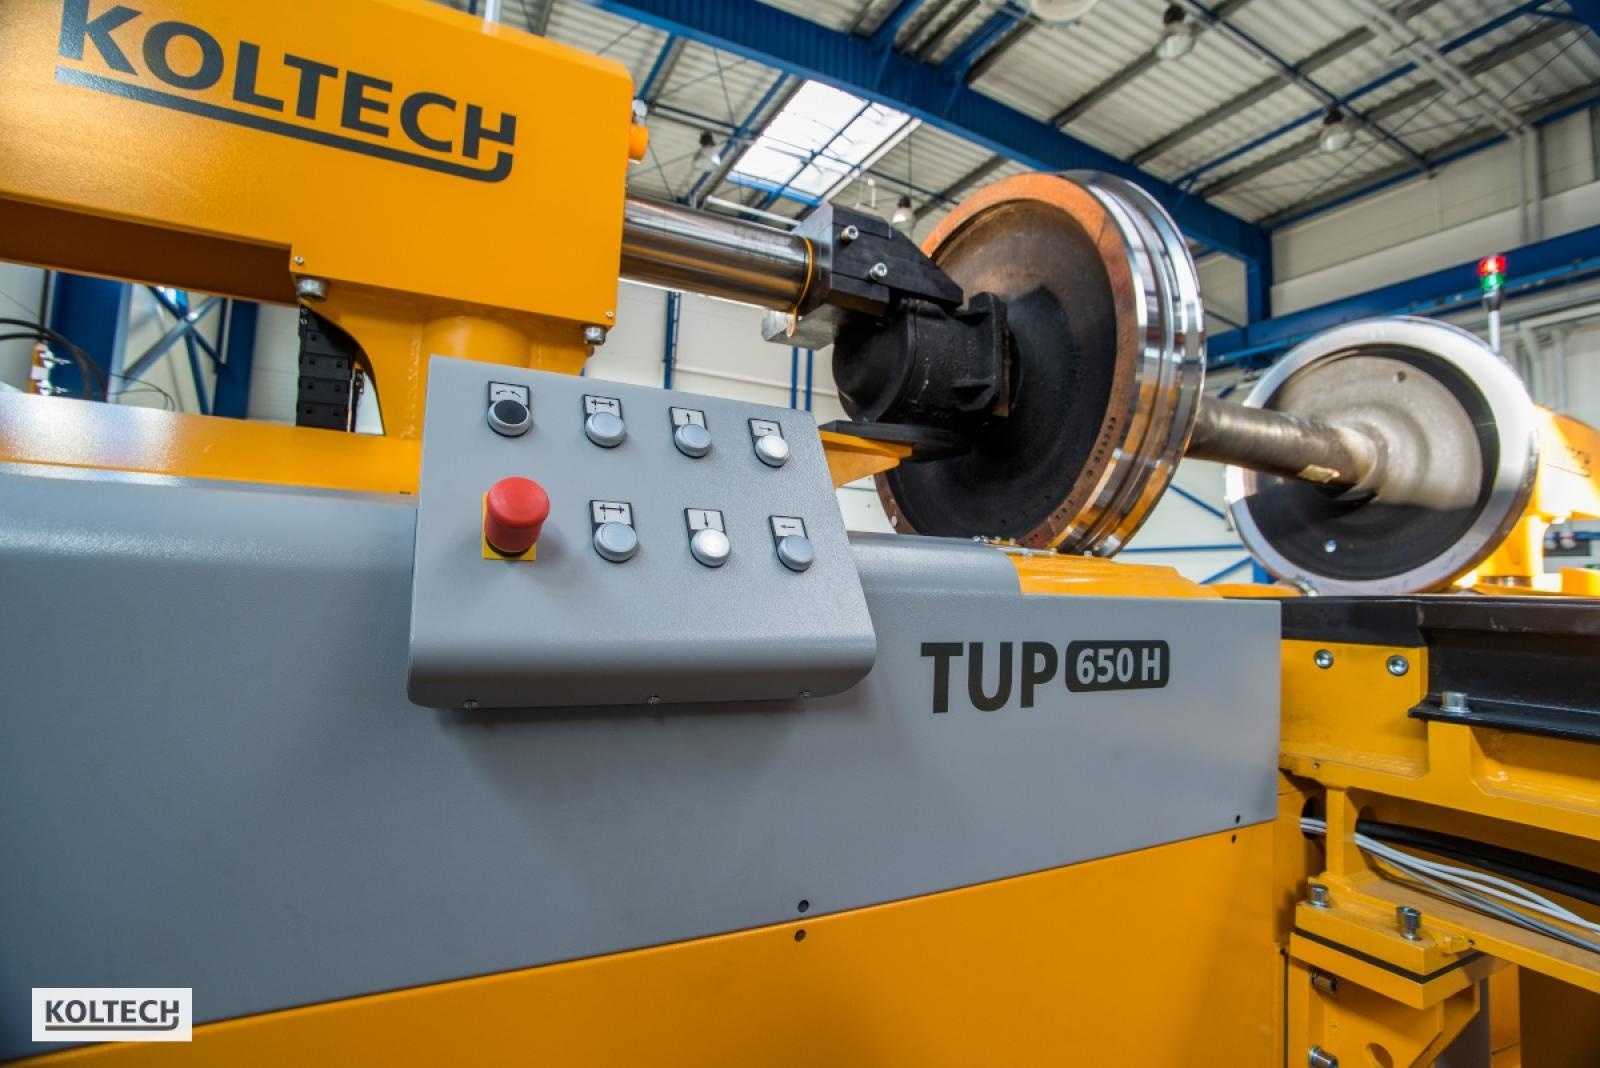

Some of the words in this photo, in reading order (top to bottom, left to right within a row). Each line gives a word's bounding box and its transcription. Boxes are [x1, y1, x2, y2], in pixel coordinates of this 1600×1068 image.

[57, 0, 517, 183] KOLTECH
[921, 641, 1058, 713] TUP
[1076, 648, 1134, 684] 650
[1141, 648, 1161, 681] H
